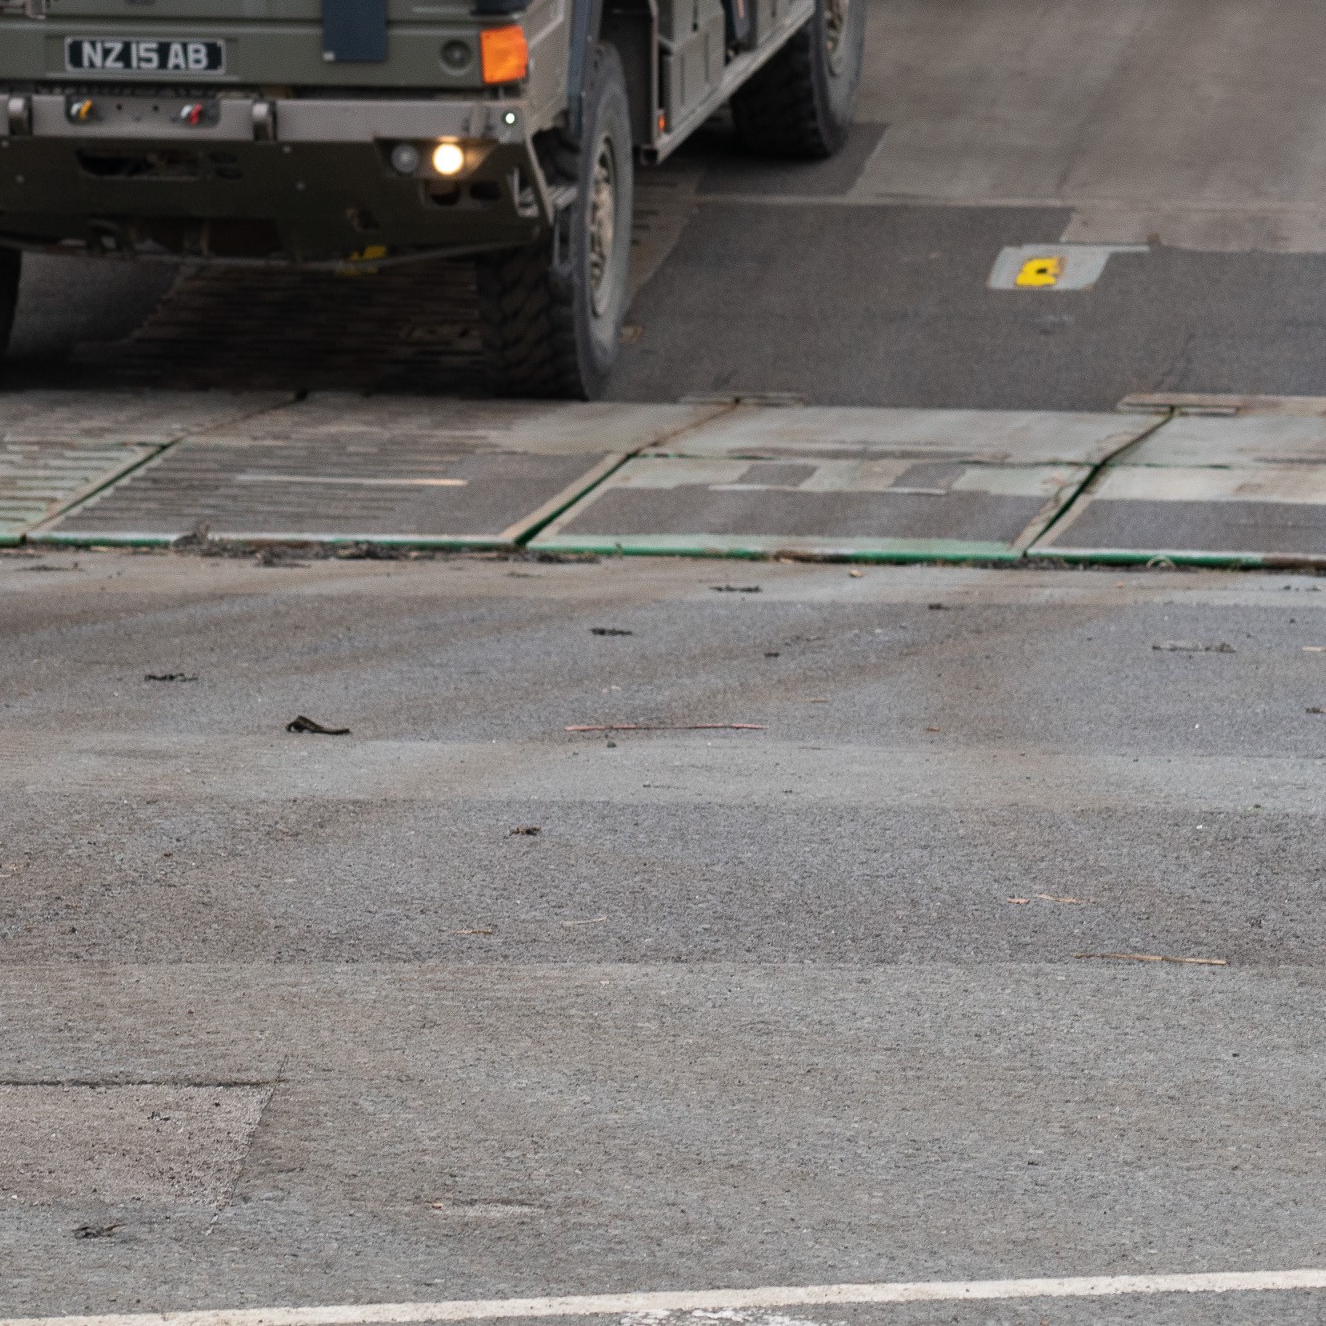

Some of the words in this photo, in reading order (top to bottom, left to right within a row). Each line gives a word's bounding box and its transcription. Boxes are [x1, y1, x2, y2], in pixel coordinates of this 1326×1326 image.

[81, 41, 125, 69] NZ
[130, 42, 159, 71] 15
[166, 43, 209, 71] AB
